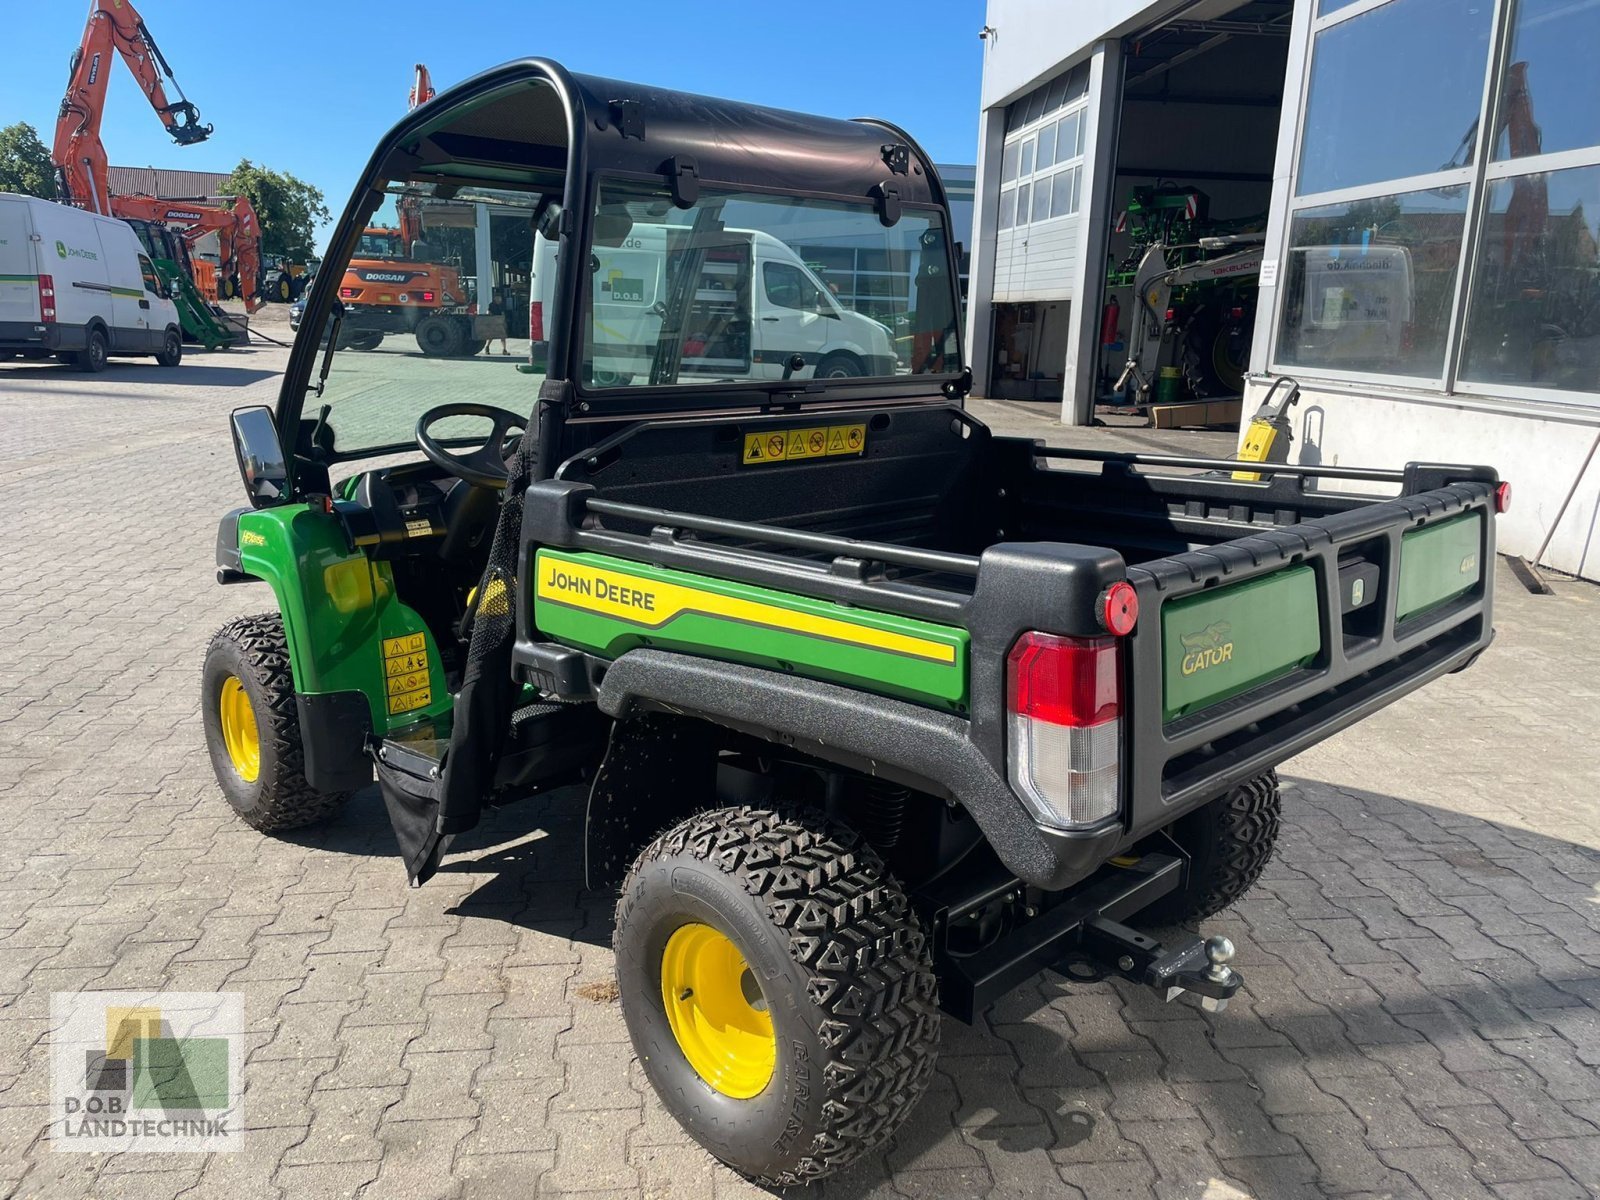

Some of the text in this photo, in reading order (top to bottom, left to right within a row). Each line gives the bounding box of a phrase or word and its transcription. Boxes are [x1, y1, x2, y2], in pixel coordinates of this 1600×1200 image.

[166, 210, 201, 220] DOOSAN
[67, 246, 98, 261] JOHN DEERE
[1210, 260, 1259, 276] TAKEUCHI
[365, 272, 406, 282] DOOSAN
[613, 291, 642, 301] D.O.B.
[547, 567, 655, 612] JOHN DEERE
[1182, 642, 1233, 675] GATOR
[772, 1039, 810, 1157] CARLISLE
